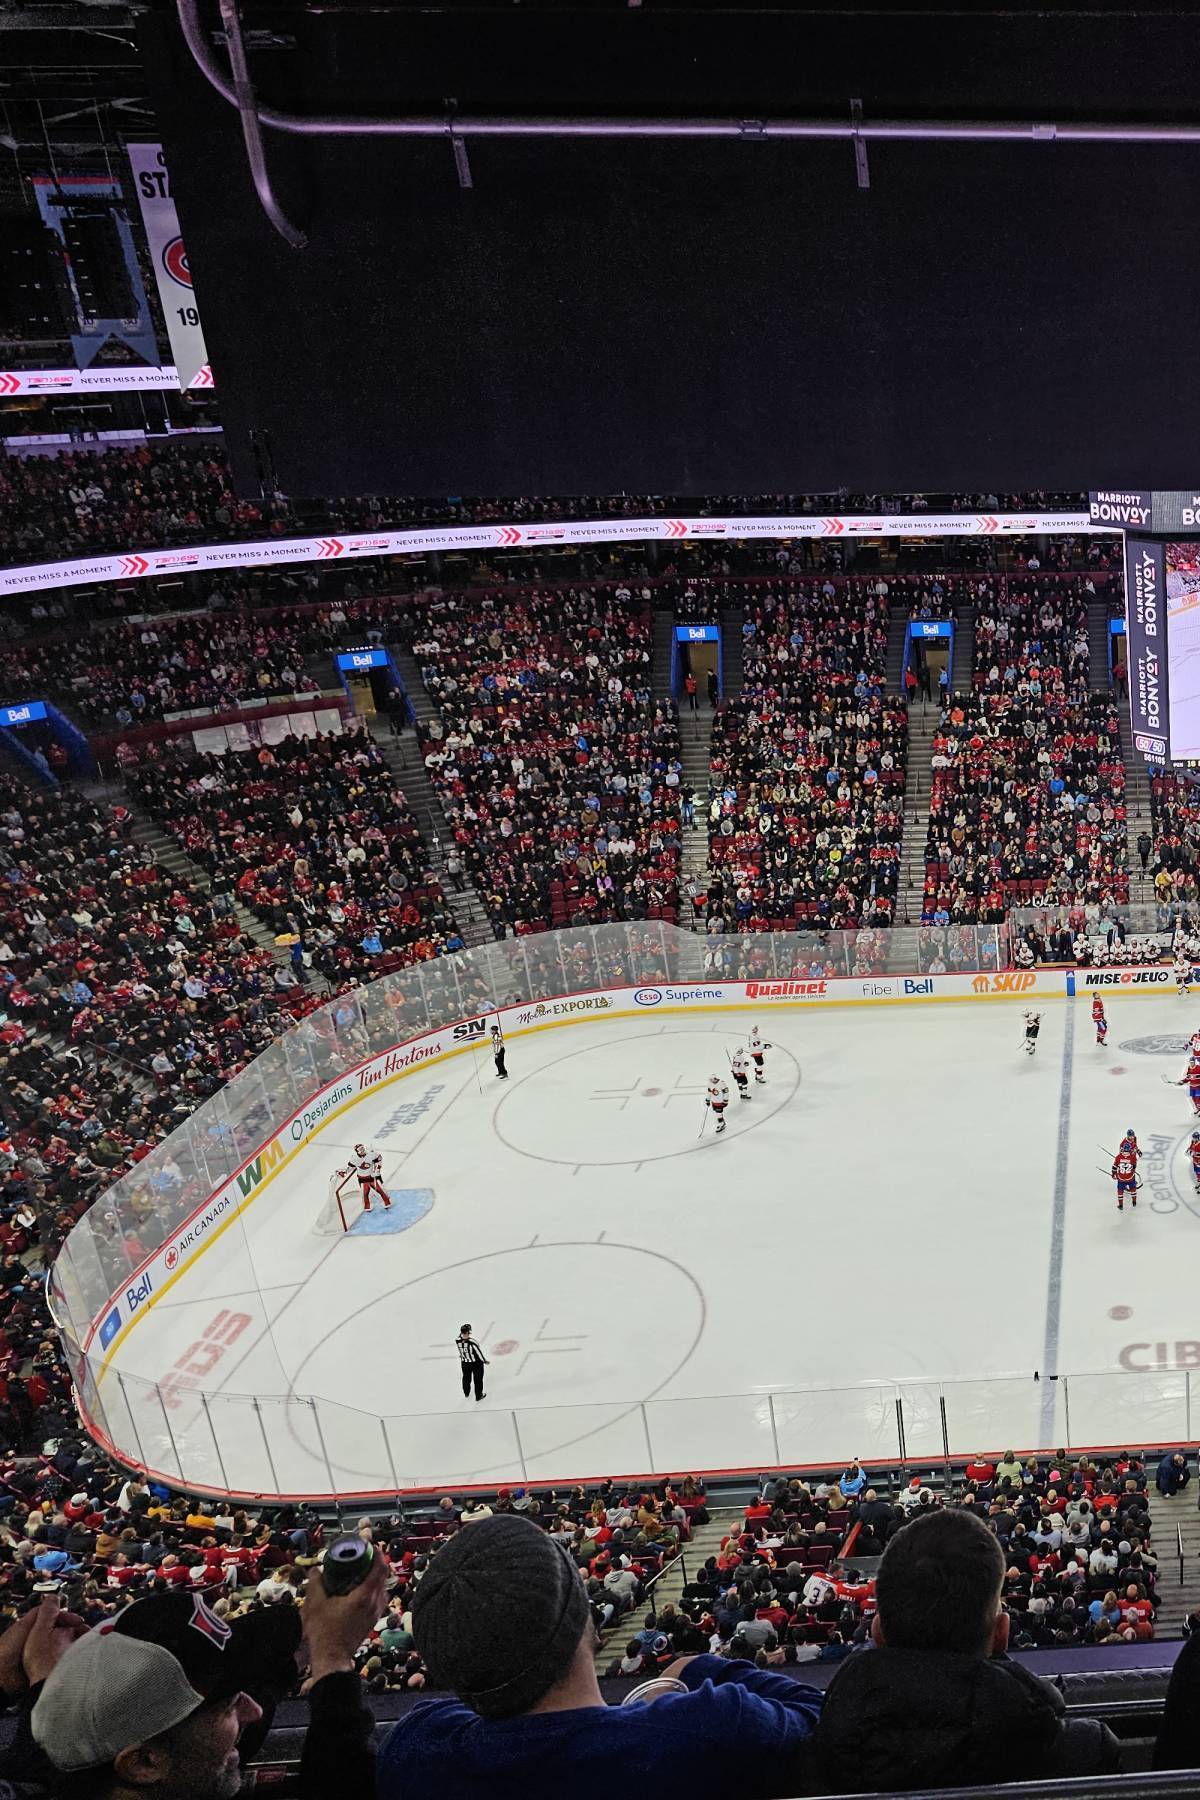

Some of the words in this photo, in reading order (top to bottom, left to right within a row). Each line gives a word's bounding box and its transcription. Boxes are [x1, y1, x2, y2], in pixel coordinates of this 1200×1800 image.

[1097, 492, 1141, 506] MARRIOTT
[1090, 502, 1151, 525] BONVOY
[1135, 563, 1144, 624] MARRIOTT
[1142, 550, 1157, 637] BONVOY
[689, 629, 706, 639] Bell
[922, 624, 939, 634] Bell
[352, 654, 373, 666] Bell
[1138, 658, 1147, 716] MARRIOTT
[1145, 646, 1160, 728] BONVOY
[7, 708, 30, 722] Bell
[745, 980, 828, 999] Qualinet
[862, 984, 892, 996] Fibe
[904, 978, 934, 994] Bell
[992, 973, 1037, 992] SKIP
[666, 988, 723, 1002] Suprême
[453, 1018, 486, 1039] SN
[355, 1065, 382, 1090] Tim
[383, 1042, 442, 1076] Hortons
[302, 1082, 353, 1128] Desjardins
[235, 1138, 286, 1198] WM
[180, 1233, 195, 1254] AIR
[194, 1196, 231, 1237] CANADA
[125, 1272, 153, 1312] Bell
